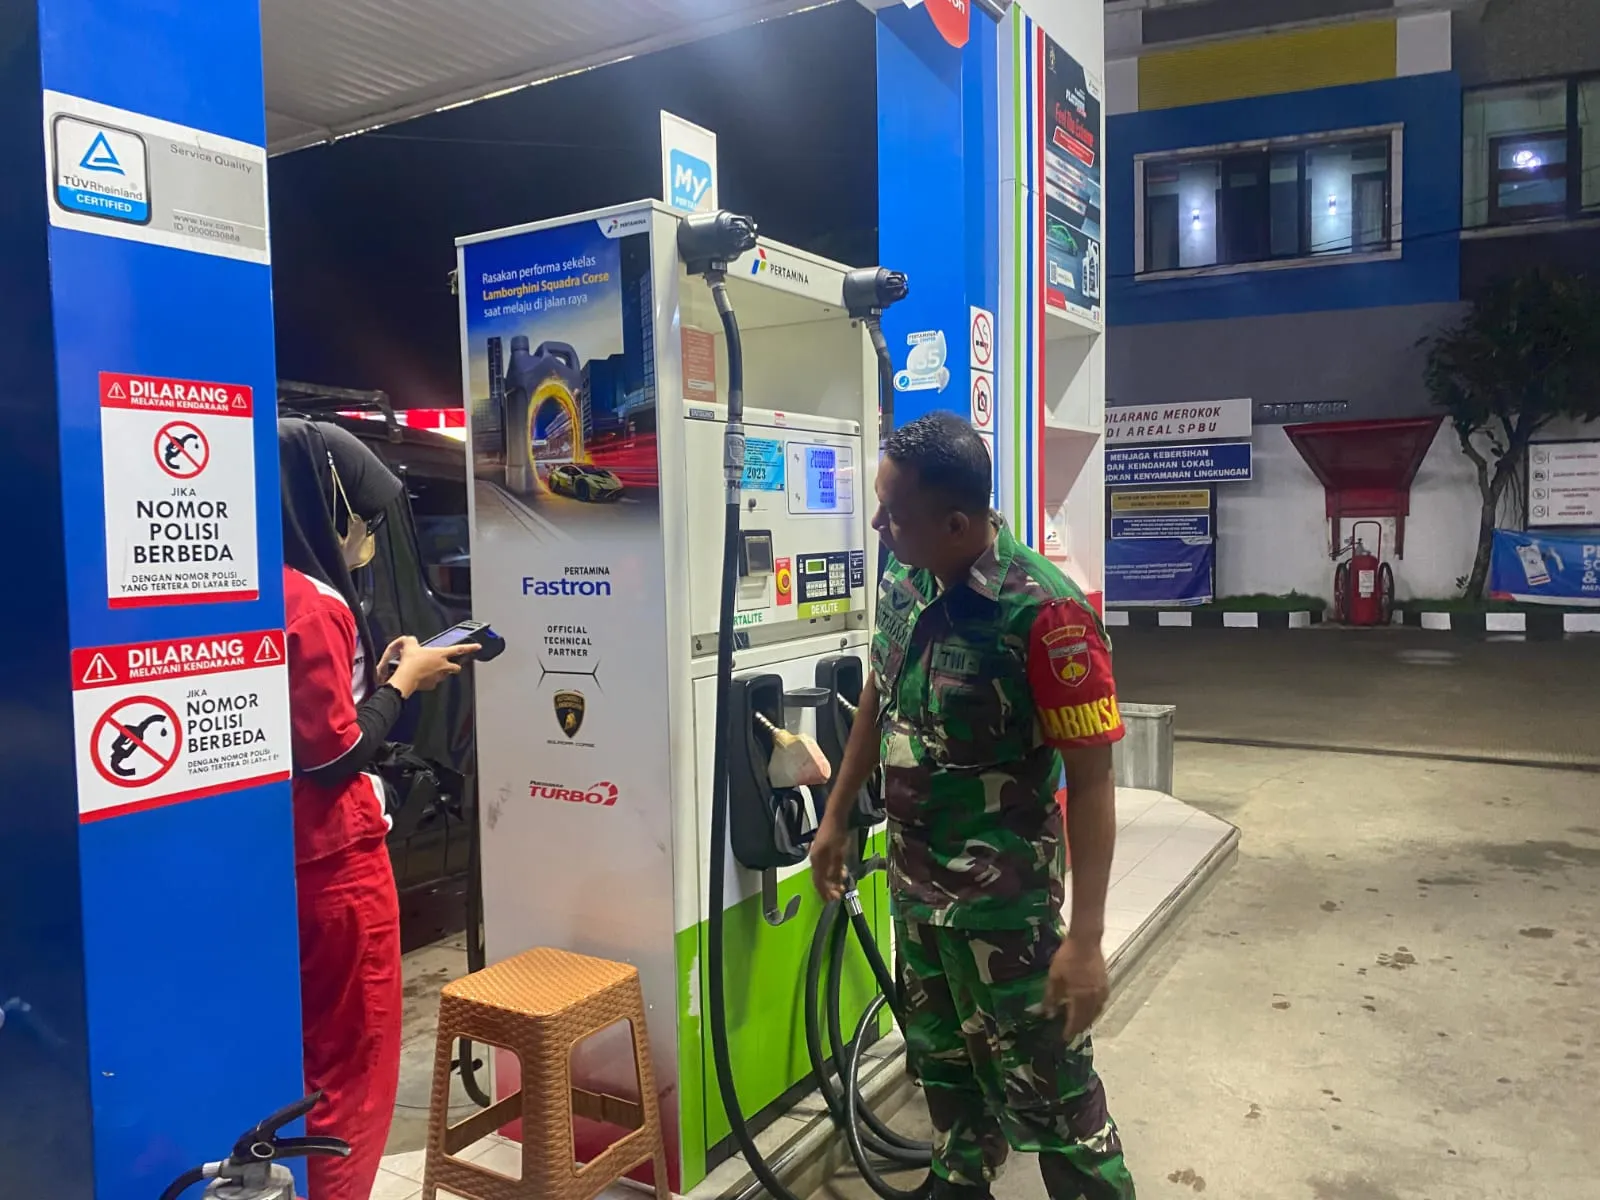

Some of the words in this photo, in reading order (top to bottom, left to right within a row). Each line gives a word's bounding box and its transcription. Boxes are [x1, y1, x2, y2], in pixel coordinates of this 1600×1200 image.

[170, 143, 212, 163] Service
[214, 154, 253, 174] Quality
[675, 163, 709, 200] MY
[76, 193, 132, 213] CERTIFIED
[173, 222, 184, 232] ID
[482, 268, 518, 285] Rasakan
[519, 262, 561, 282] performa
[562, 255, 597, 272] sekelas
[769, 263, 809, 286] PERTAMINA
[482, 281, 540, 301] Lamborghini
[541, 274, 581, 293] Squadra
[582, 271, 610, 286] Corse
[483, 304, 501, 318] saat
[502, 299, 533, 316] melaju
[533, 297, 543, 311] di
[543, 294, 566, 312] jalan
[568, 292, 588, 308] raya
[129, 379, 229, 404] DILARANG
[130, 397, 175, 408] MELAYANI
[176, 399, 229, 412] KENDARAAN
[1162, 406, 1222, 421] MEROKOK
[1106, 427, 1121, 438] DI
[1126, 423, 1173, 437] AREAL
[1177, 421, 1217, 434] SPBU
[1110, 452, 1151, 461] MENJAGA
[1153, 449, 1209, 460] KEBERSIHAN
[746, 466, 767, 480] 2023
[1106, 463, 1125, 471] DAN
[1127, 460, 1178, 471] KEINDAHAN
[1181, 458, 1214, 468] LOKASI
[1133, 470, 1191, 481] KENYAMANAN
[1193, 467, 1249, 479] LINGKUNGAN
[170, 487, 197, 497] JIKA
[136, 500, 229, 519] NOMOR
[150, 523, 219, 541] POLISI
[133, 544, 234, 564] BERBEDA
[131, 574, 173, 584] DENGAN
[174, 572, 210, 582] NOMOR
[212, 570, 238, 580] POLISI
[564, 566, 610, 576] PERTAMINA
[1582, 570, 1597, 584] &
[120, 583, 149, 593] YANG
[151, 581, 189, 592] TERTERA
[191, 580, 202, 590] DI
[202, 579, 231, 589] LAYAR
[231, 578, 248, 588] EDC
[522, 577, 611, 597] Fastron
[811, 603, 839, 615] DEXLITE
[547, 625, 588, 634] OFFICIAL
[543, 636, 592, 646] TECHNICAL
[128, 638, 244, 669] DILARANG
[548, 648, 588, 657] PARTNER
[129, 663, 181, 679] MELAYANI
[183, 656, 245, 672] KENDARAAN
[186, 689, 208, 699] JIKA
[187, 693, 259, 717] NOMOR
[188, 713, 243, 735] POLISI
[188, 728, 266, 753] BERBEDA
[188, 757, 219, 769] DENGAN
[221, 751, 248, 762] NOMOR
[188, 765, 209, 775] YANG
[211, 759, 240, 770] TERTERA
[529, 785, 603, 805] TURBO
